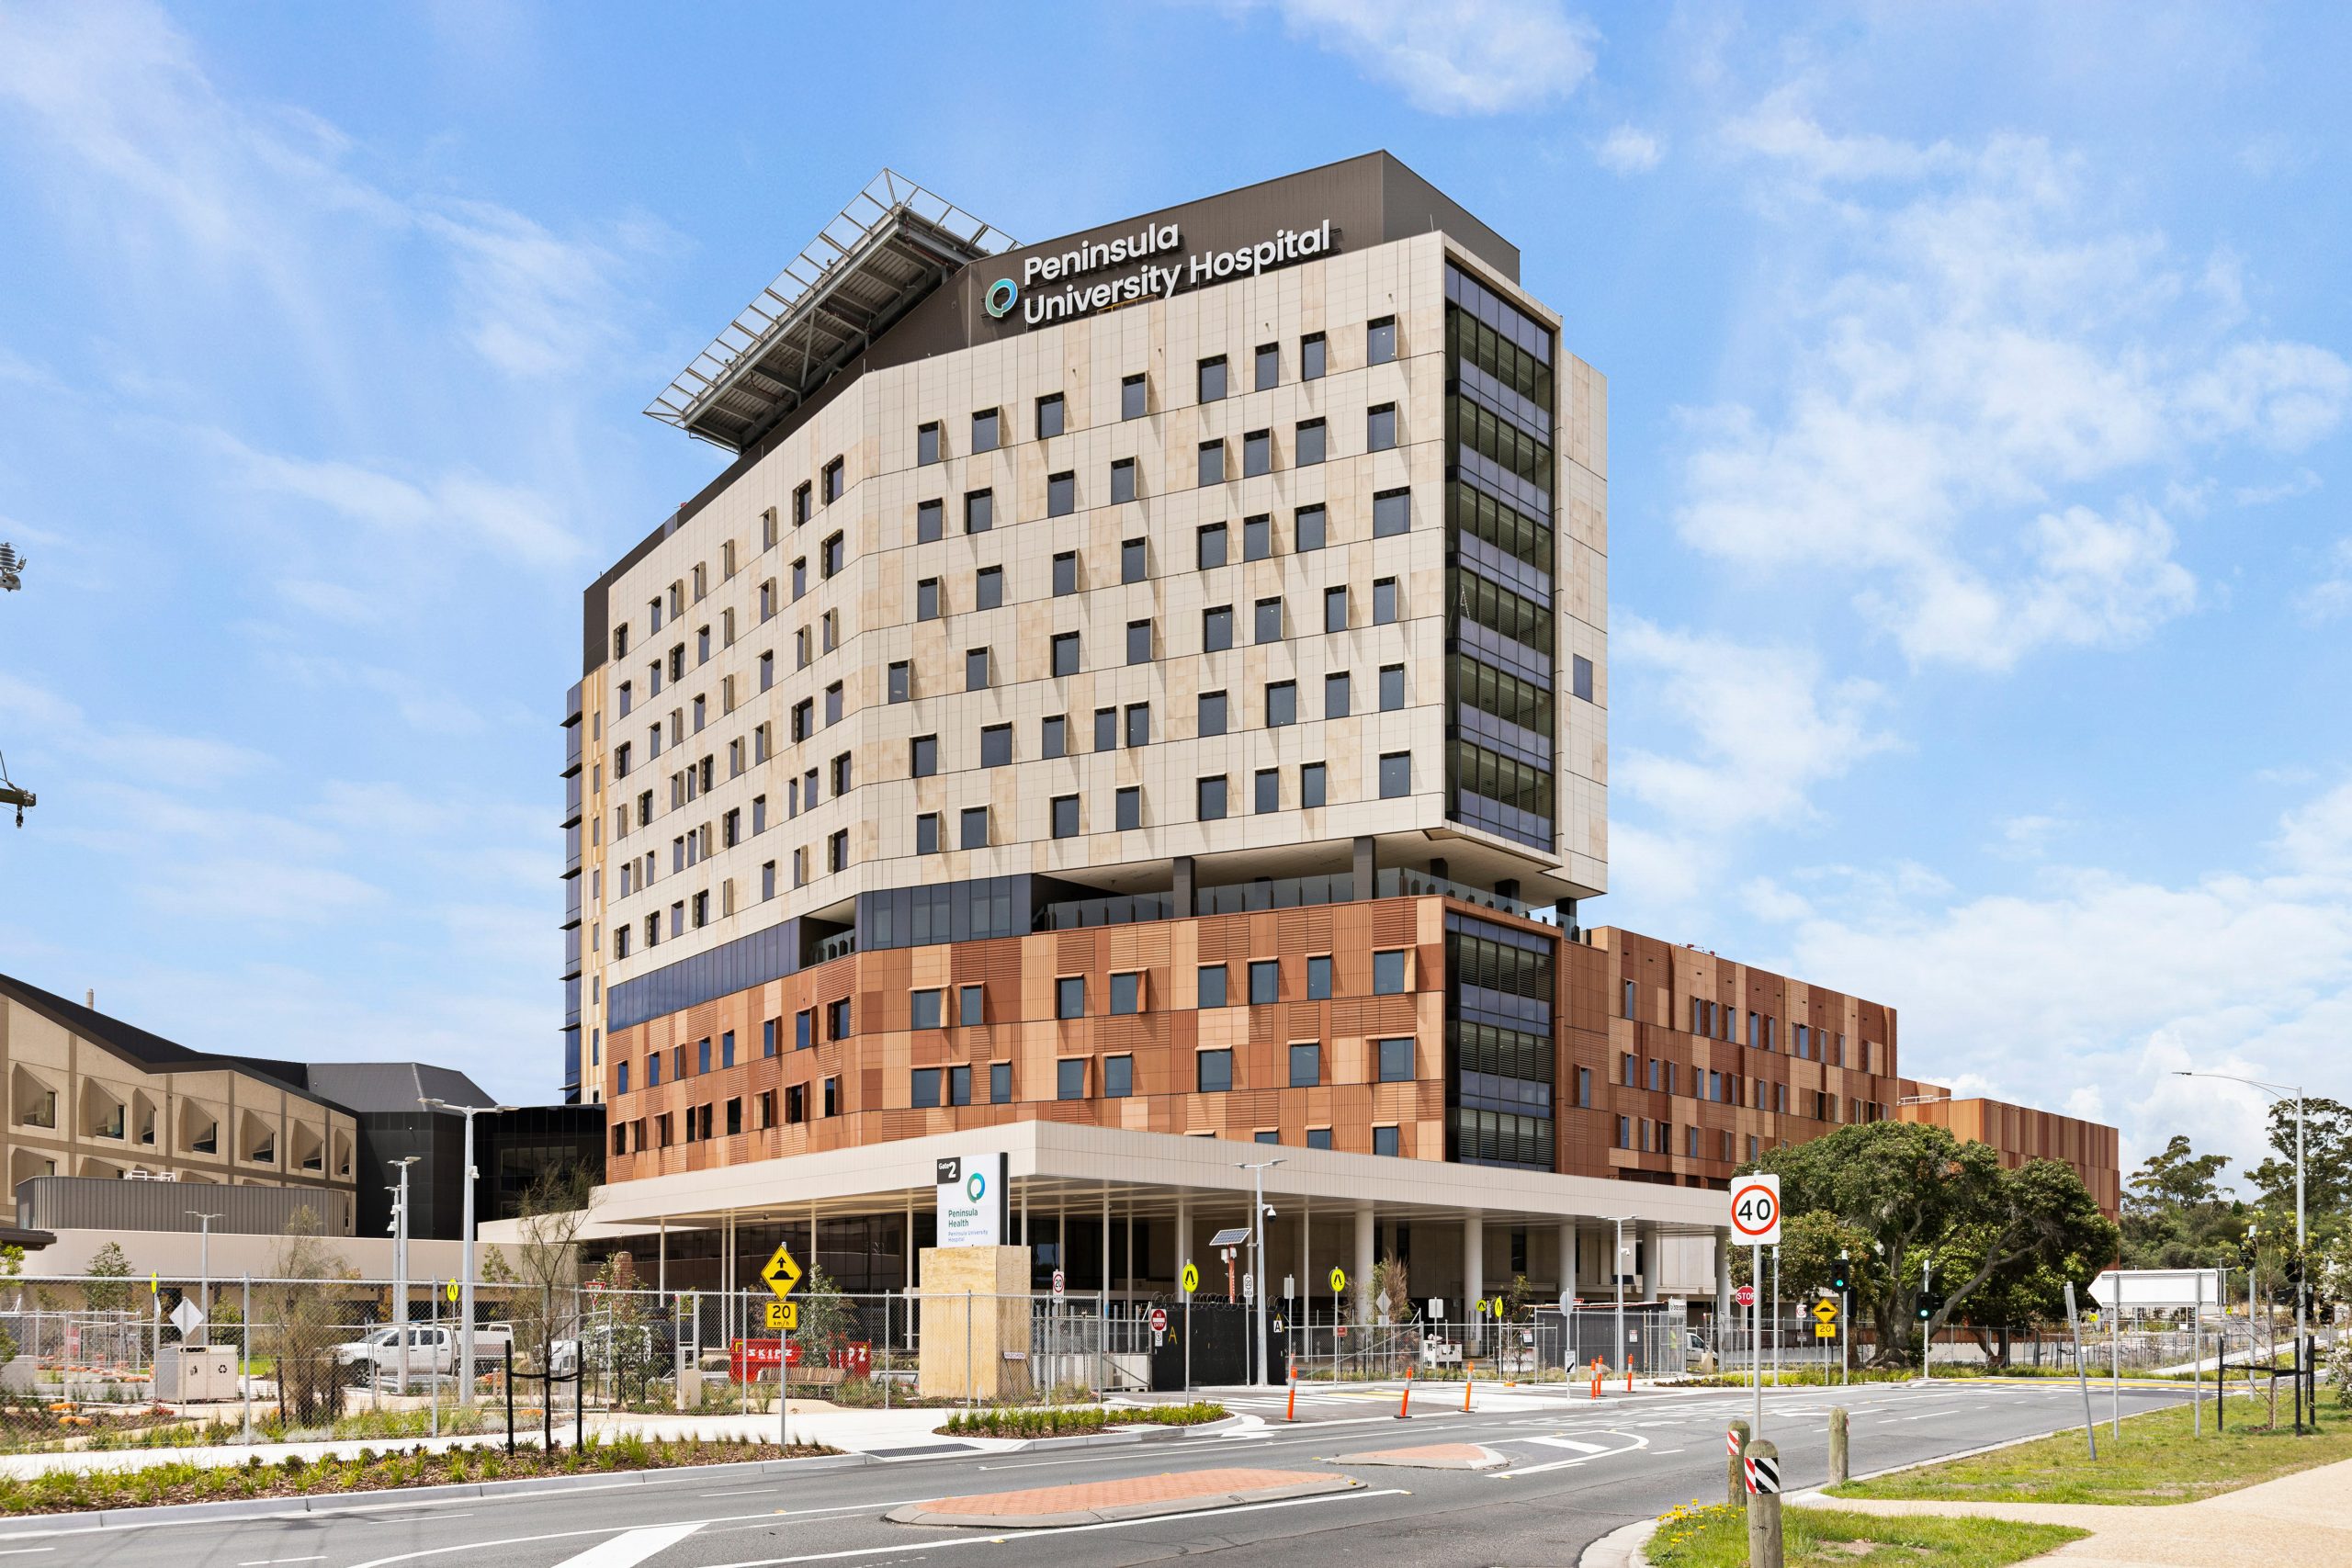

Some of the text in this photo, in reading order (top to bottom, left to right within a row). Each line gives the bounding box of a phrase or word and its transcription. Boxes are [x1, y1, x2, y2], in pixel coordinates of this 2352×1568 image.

[1023, 222, 1179, 286] Peninsula
[1023, 219, 1330, 324] University Hospital
[938, 1161, 956, 1179] Gate 2
[948, 1208, 978, 1217] Peninsula
[1738, 1199, 1770, 1221] 40
[948, 1219, 969, 1228] Health
[773, 1305, 791, 1319] 20
[1274, 1321, 1282, 1332] A
[1168, 1325, 1178, 1345] A
[748, 1348, 793, 1357] SKIPZ
